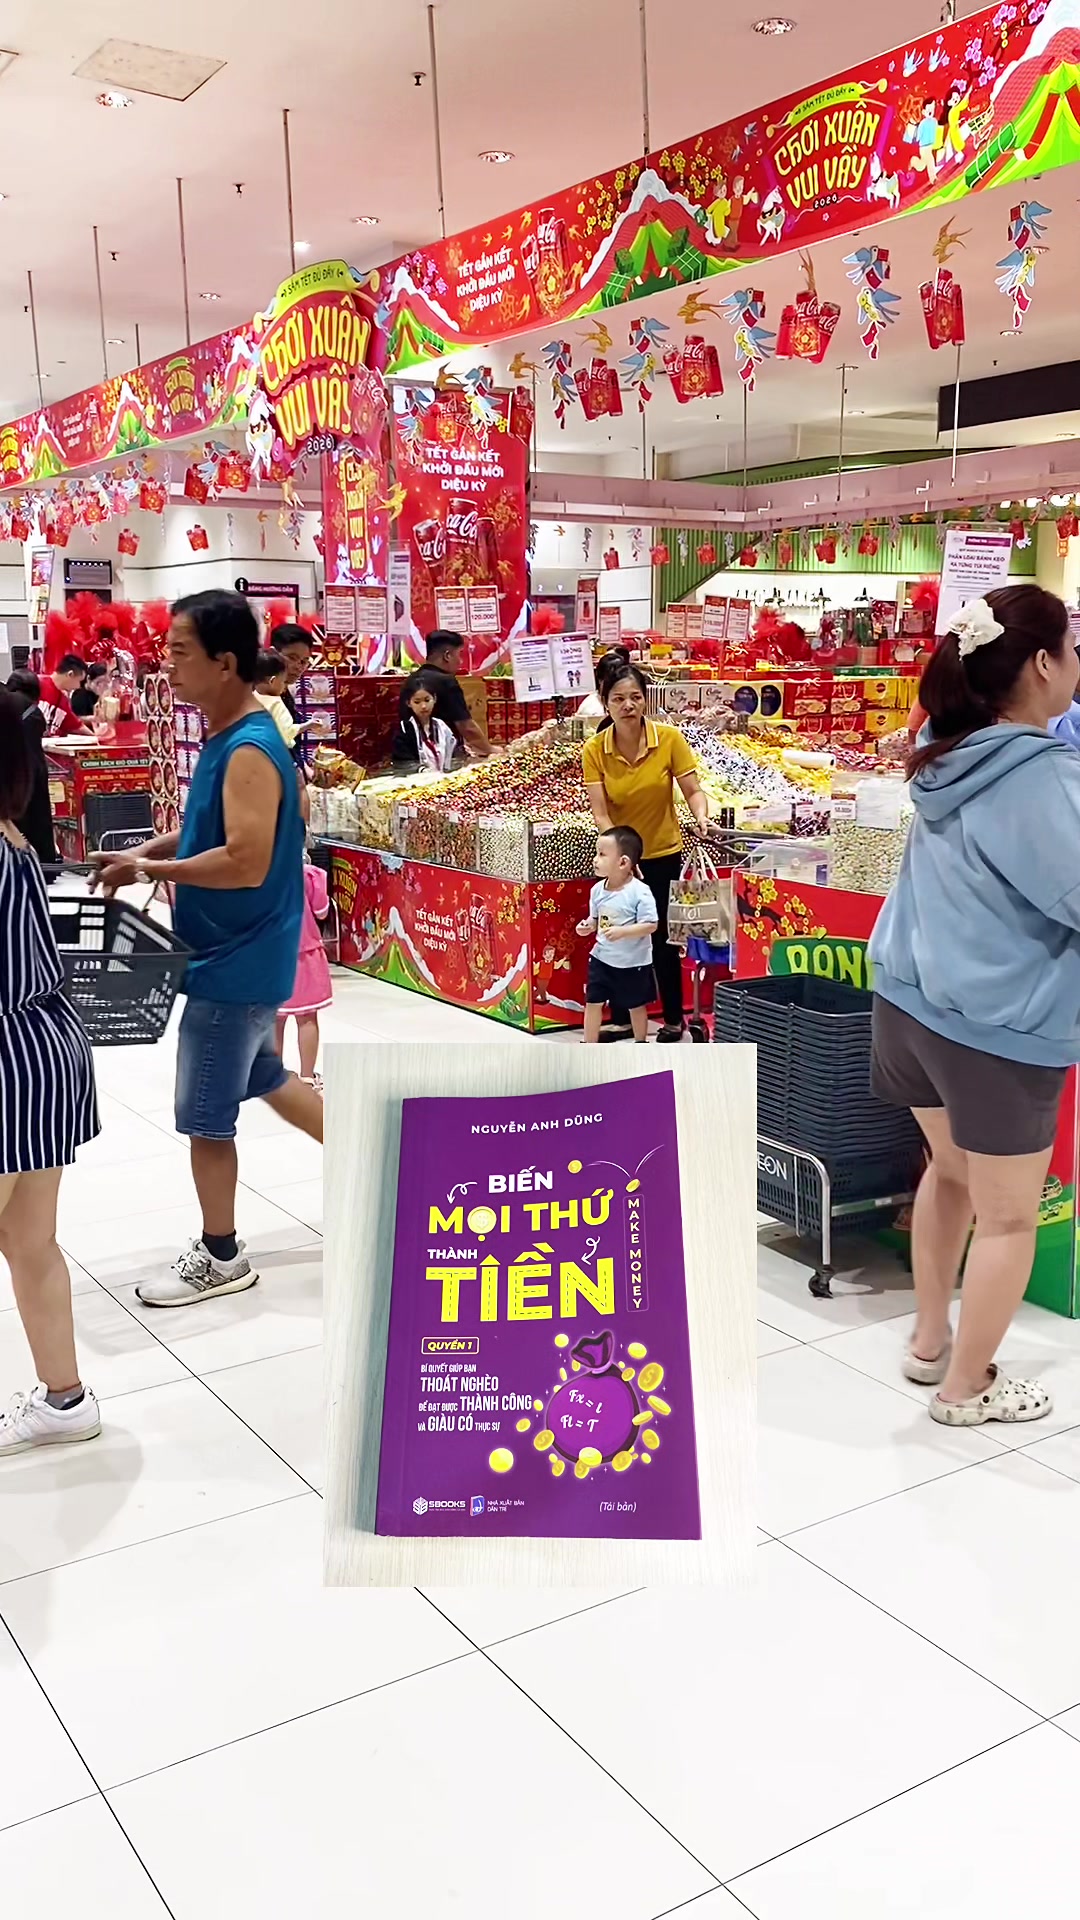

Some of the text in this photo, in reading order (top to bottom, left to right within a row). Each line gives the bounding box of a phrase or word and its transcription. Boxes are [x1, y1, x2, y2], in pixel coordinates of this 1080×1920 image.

[824, 100, 880, 147] XUÂN
[786, 145, 867, 208] VUI VẦY
[814, 194, 837, 208] 2026
[458, 245, 513, 278] TẾT GẮN KẾT
[457, 278, 478, 297] KHỞI
[498, 264, 515, 283] MỚI
[470, 288, 503, 312] DIỆU KỲ
[308, 295, 369, 366] XUÂN
[275, 382, 311, 446] VUI
[307, 435, 333, 453] 2026
[426, 445, 500, 463] TẾT GẮN KẾT
[423, 461, 452, 475] KHỞI
[482, 464, 504, 478] MỚI
[441, 478, 487, 492] DIỆU KỲ
[416, 907, 427, 921] TẾT
[442, 912, 454, 927] KẾT
[415, 922, 429, 935] KHỞI
[424, 937, 448, 952] DIỆU KỲ
[472, 1113, 603, 1134] NGUYỄN ANH DŨNG
[757, 1151, 787, 1180] EON
[488, 1166, 553, 1194] BIẾN
[428, 1188, 614, 1242] MỌI THỨ
[628, 1198, 640, 1244] MAKE
[428, 1247, 478, 1260] THÀNH
[630, 1249, 642, 1309] MONEY
[428, 1339, 473, 1352] QUYỂN 1
[421, 1362, 477, 1374] BÍ QUYẾT GIÚP BẠN
[421, 1374, 499, 1392] THOÁT NGHÈO
[419, 1392, 532, 1413] ĐỂ ĐẠT ĐƯỢC THÀNH CÔNG
[569, 1390, 585, 1404] Fx
[586, 1400, 594, 1408] =
[418, 1413, 501, 1432] VÀ GIÀU CÓ THỰC SỰ
[575, 1420, 584, 1428] =
[587, 1419, 599, 1432] T
[600, 1502, 637, 1513] (Tái bản)
